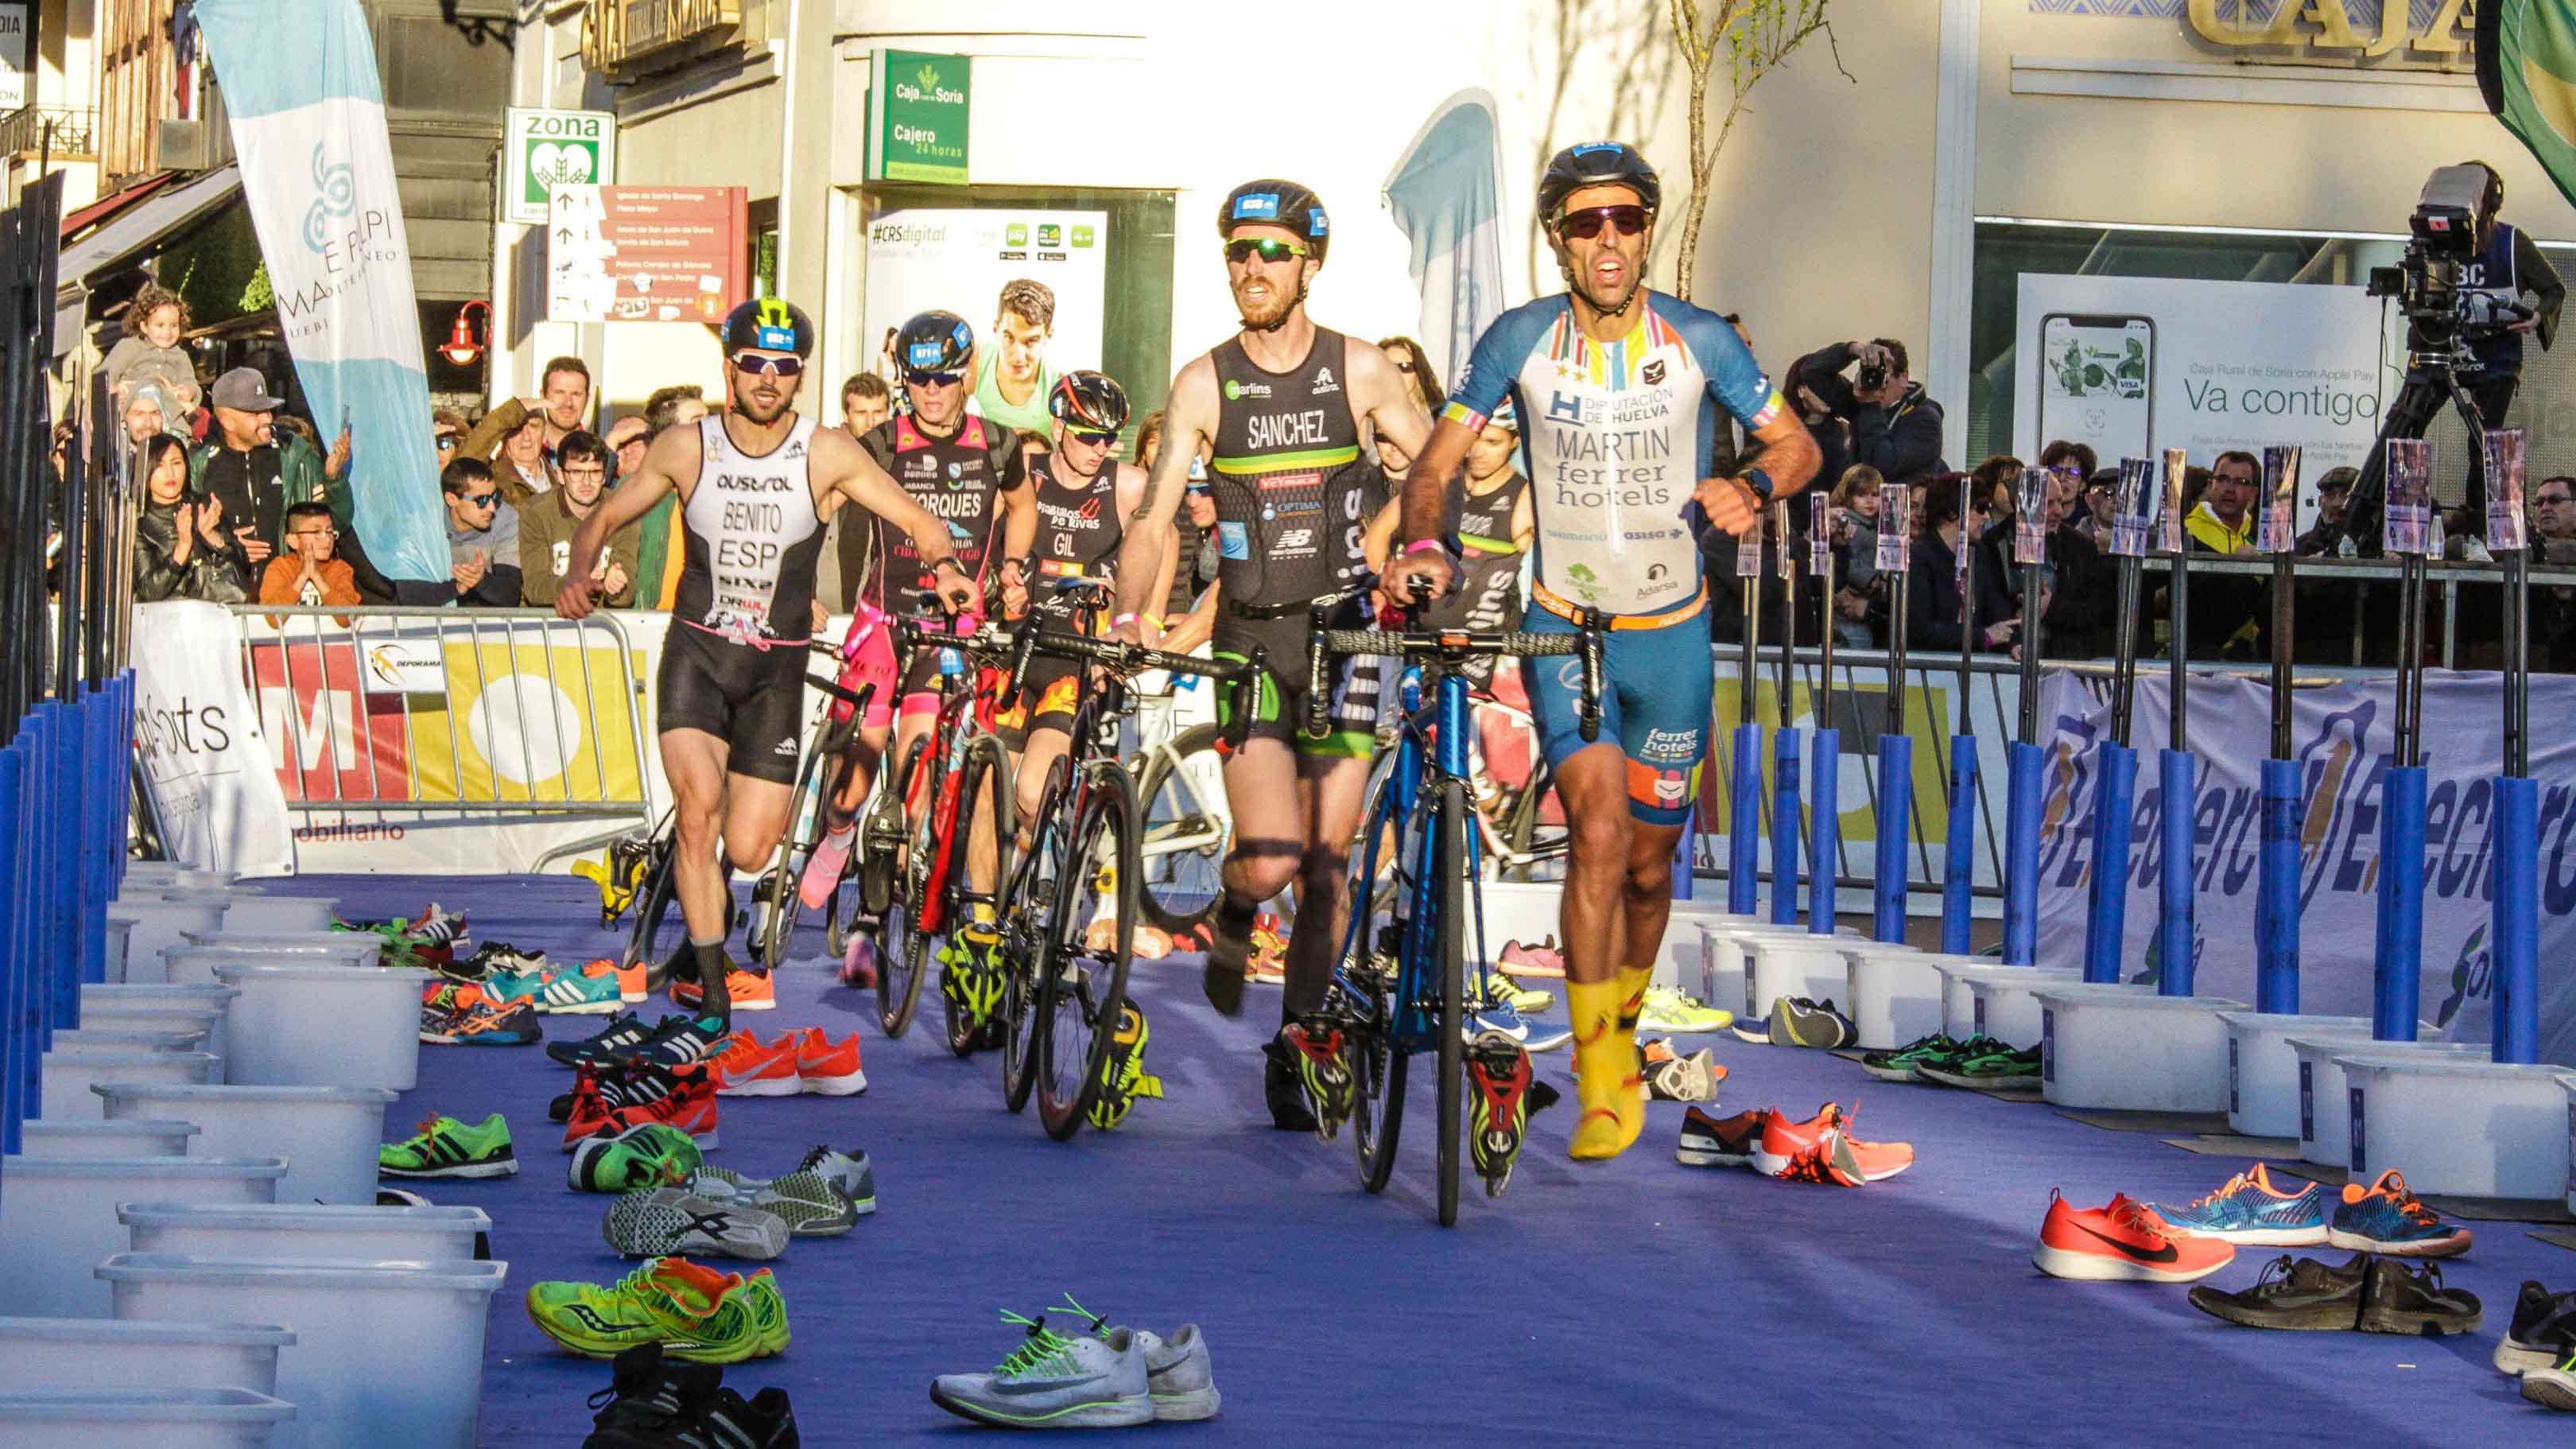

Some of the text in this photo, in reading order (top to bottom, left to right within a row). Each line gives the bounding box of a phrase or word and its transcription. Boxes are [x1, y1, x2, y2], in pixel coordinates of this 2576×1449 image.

[896, 84, 920, 102] Caja
[936, 87, 963, 103] Soria
[526, 116, 599, 137] zona
[894, 124, 936, 145] Cajero
[916, 143, 962, 157] 24 horas
[2217, 363, 2245, 376] Rural
[2320, 369, 2350, 382] Apple
[1230, 383, 1271, 394] marlins
[2184, 378, 2377, 425] Va contigo
[1585, 404, 1670, 423] DE HUELVA
[1247, 410, 1329, 449] SANCHEZ
[1556, 426, 1670, 461] MARTIN
[1557, 461, 1666, 484] ferrer
[909, 493, 981, 518] ORQUES
[1556, 484, 1670, 507] hotels
[723, 500, 782, 534] BENITO
[718, 538, 778, 569] ESP
[1054, 533, 1075, 557] GIL
[1643, 740, 1697, 752] hotels
[1649, 728, 1698, 741] ferrer
[293, 818, 405, 843] obiliario
